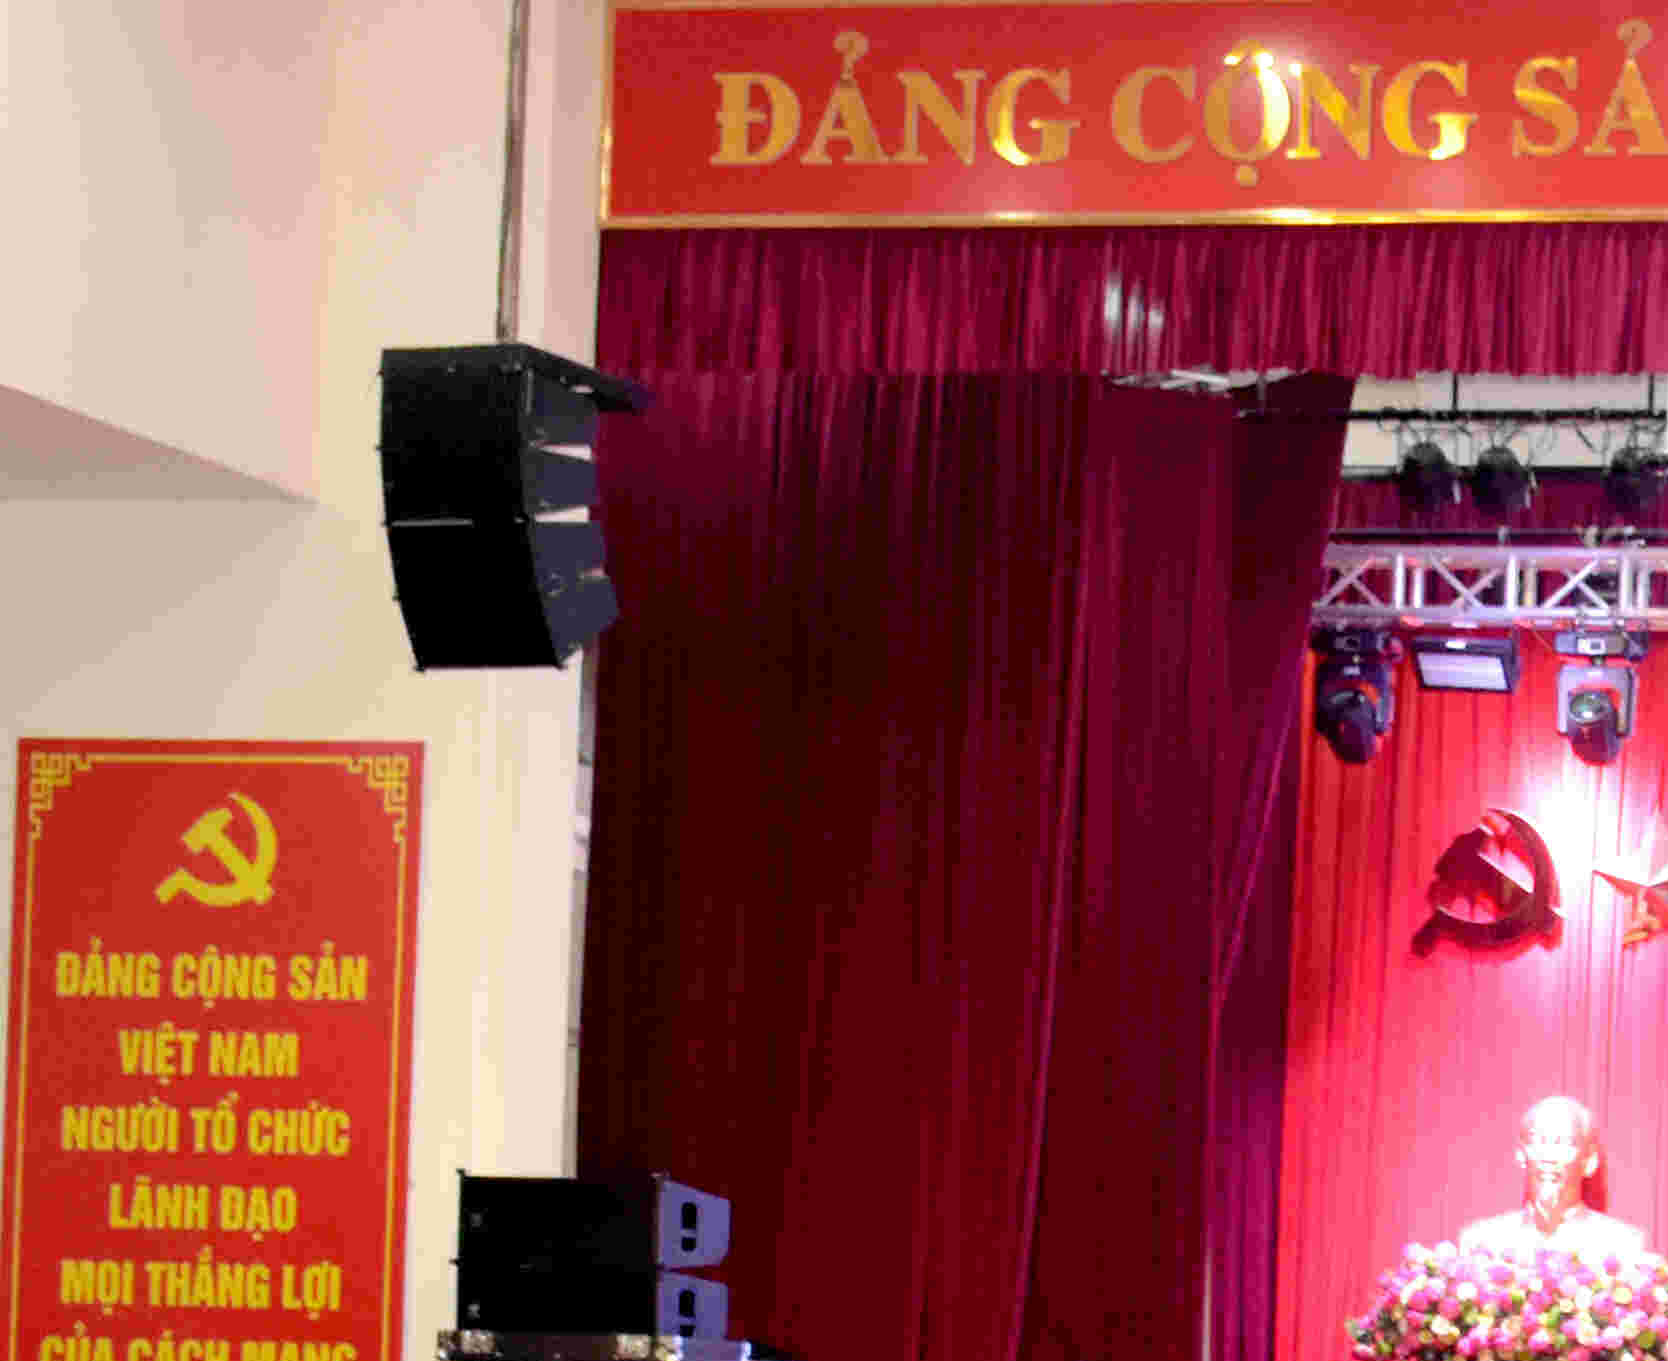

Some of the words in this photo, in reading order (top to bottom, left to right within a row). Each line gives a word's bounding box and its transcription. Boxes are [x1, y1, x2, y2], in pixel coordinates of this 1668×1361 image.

[709, 30, 1080, 166] ĐẢNG
[1108, 48, 1475, 187] CỘNG
[56, 938, 160, 1000] ĐẢNG
[172, 944, 276, 1009] CỘNG
[289, 940, 368, 1002] SẢN
[119, 1022, 196, 1085] VIỆT
[208, 1032, 299, 1078] NAM
[62, 1098, 177, 1154] NGƯỜI
[190, 1091, 239, 1154] TỔ
[249, 1100, 351, 1157] CHỨC
[109, 1176, 207, 1232] LÃNH
[220, 1186, 297, 1242] ĐẠO
[60, 1260, 135, 1314] MỌI
[282, 1262, 342, 1320] LỢI
